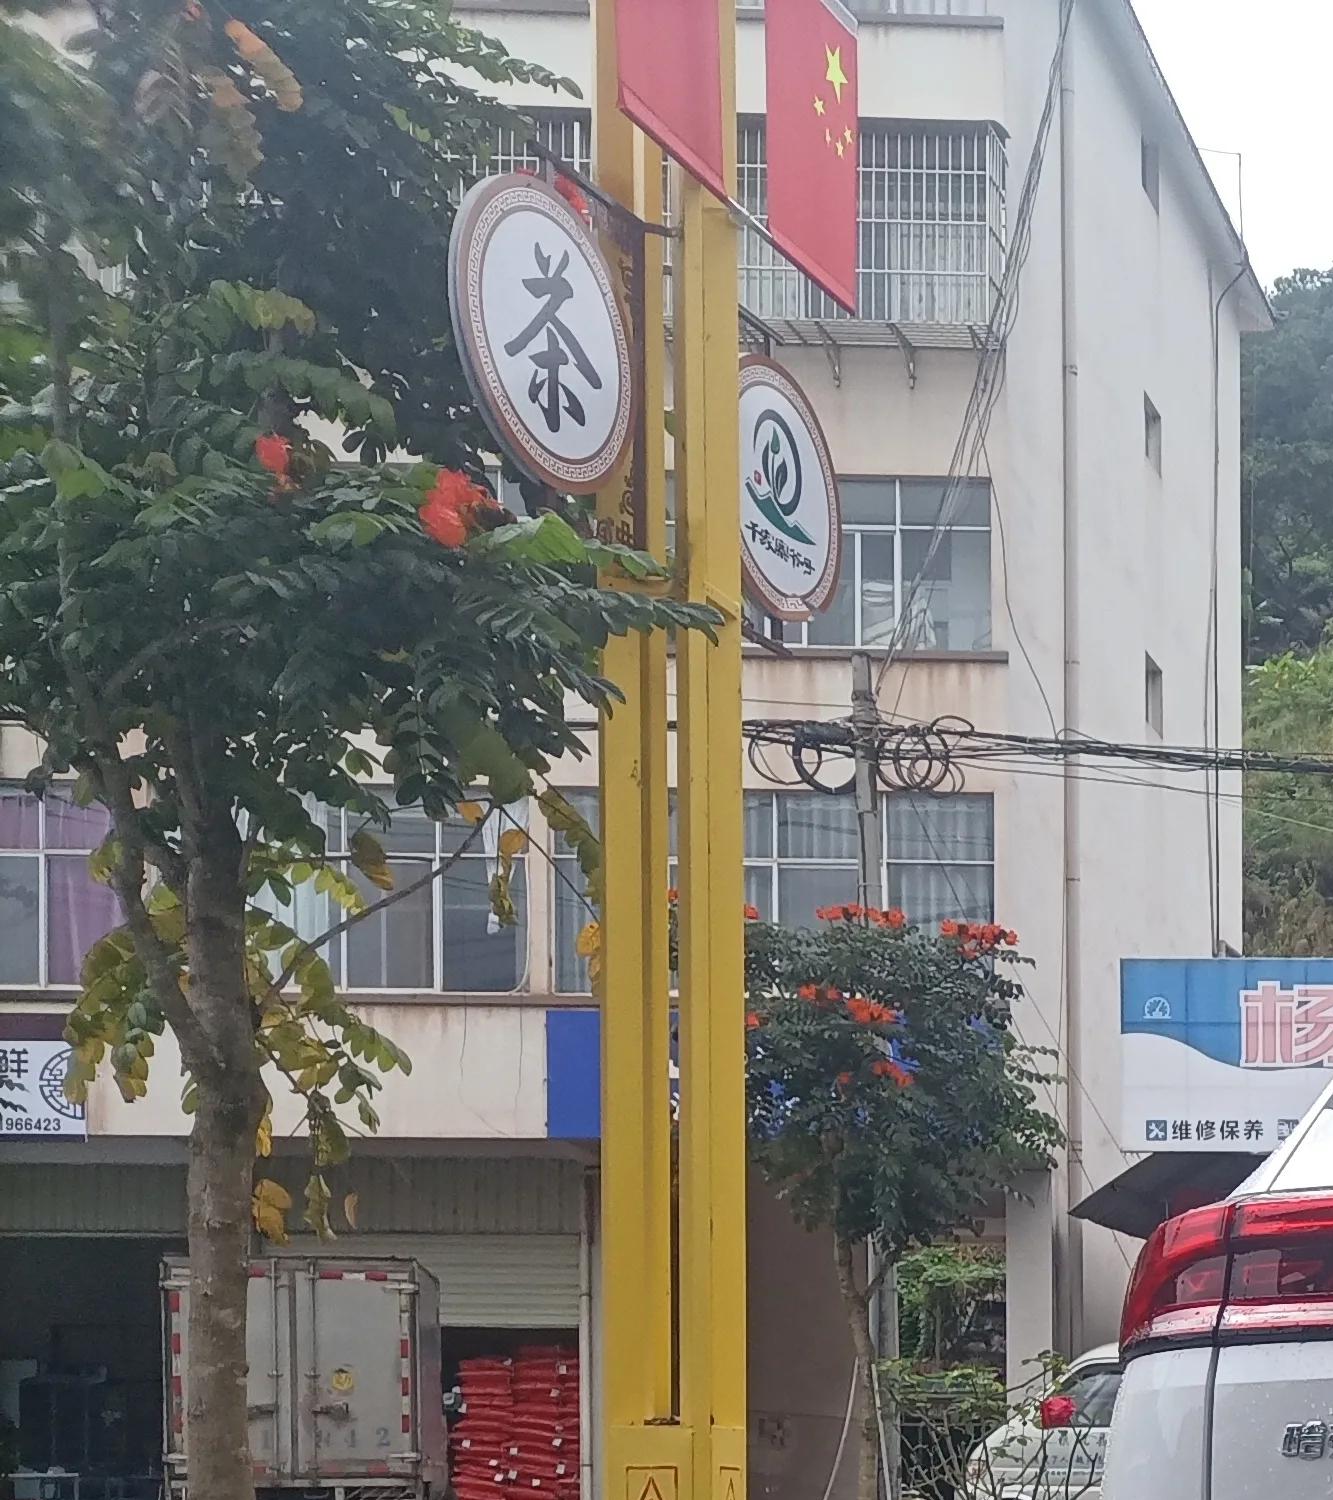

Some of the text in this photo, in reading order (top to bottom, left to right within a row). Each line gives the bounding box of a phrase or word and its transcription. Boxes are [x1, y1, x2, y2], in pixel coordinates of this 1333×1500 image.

[504, 242, 602, 433] 茶
[1171, 1118, 1265, 1141] 维修保养
